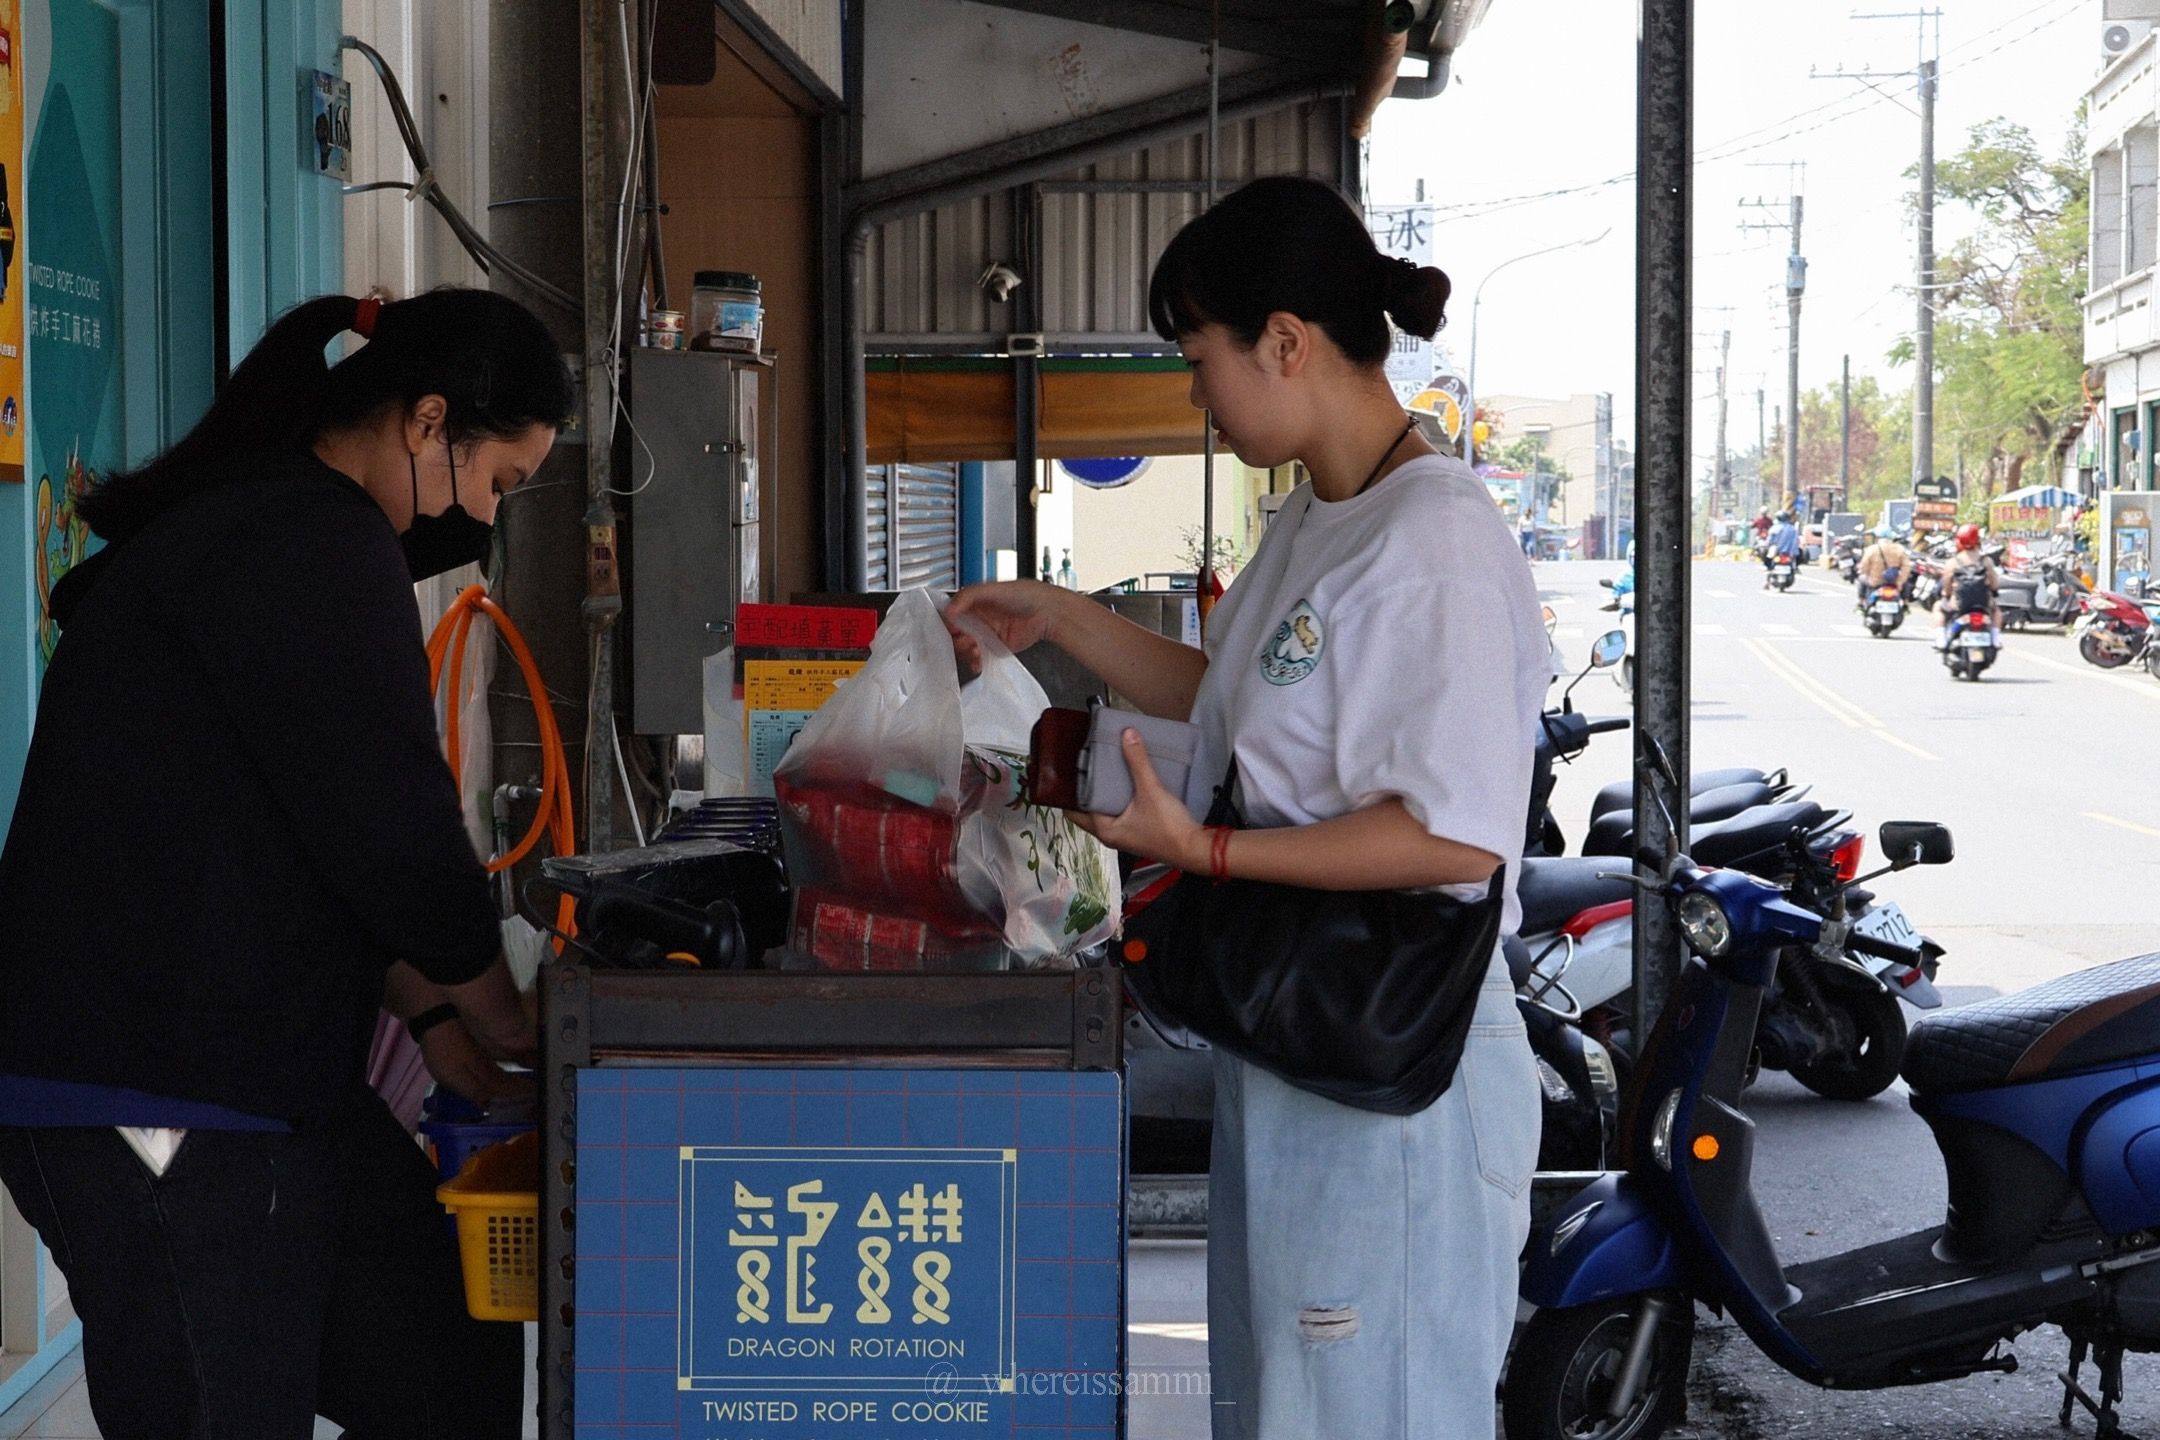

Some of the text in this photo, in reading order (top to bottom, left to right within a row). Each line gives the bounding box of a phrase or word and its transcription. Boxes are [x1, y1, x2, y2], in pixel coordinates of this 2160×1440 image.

[327, 102, 351, 152] 168
[1386, 208, 1427, 251] 冰
[30, 262, 100, 300] TWISTED ROPE COOKIE
[728, 1337, 965, 1358] DRAGON ROTATION
[702, 1401, 989, 1423] TWISTED ROPE COOKIE
